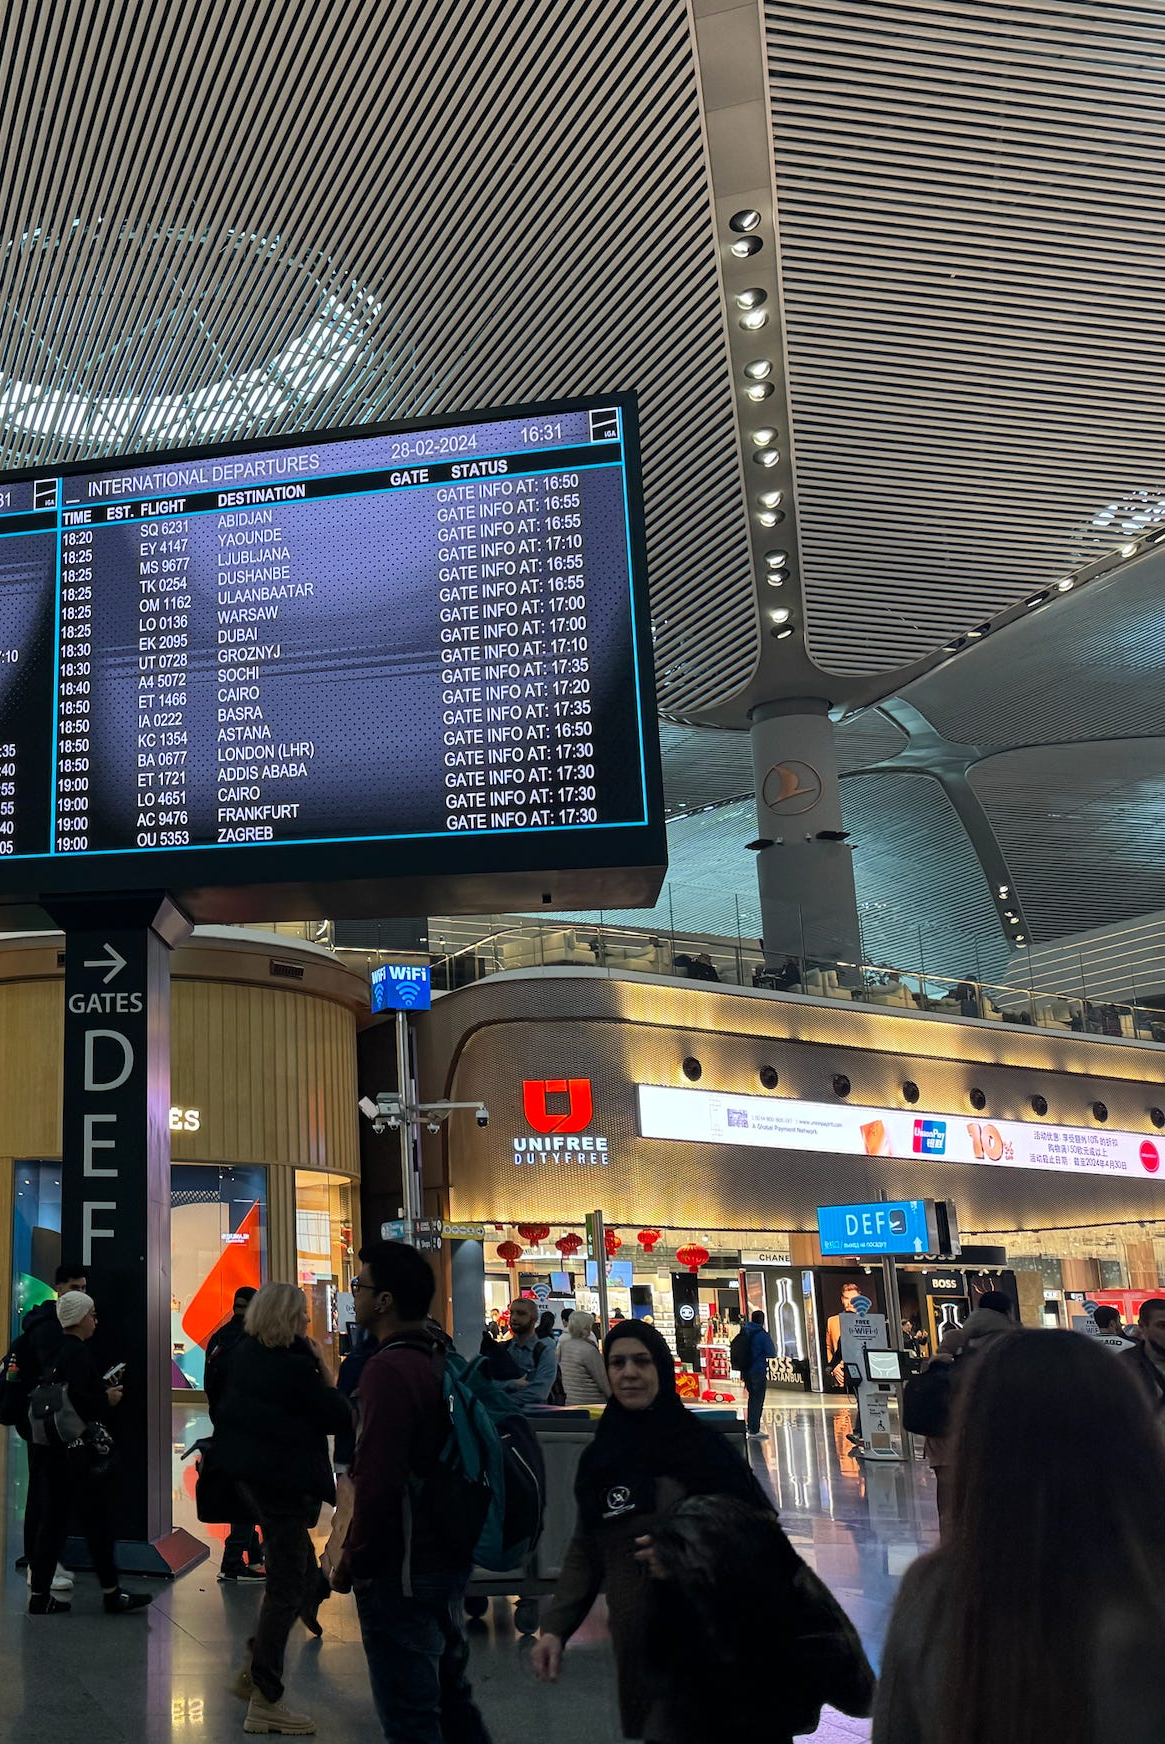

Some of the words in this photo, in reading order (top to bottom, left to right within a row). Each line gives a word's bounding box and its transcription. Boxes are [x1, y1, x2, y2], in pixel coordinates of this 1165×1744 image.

[88, 468, 208, 496] INTERNATIONAL
[212, 453, 319, 481] DEPARTURES
[391, 433, 477, 459] 28-02-2024
[520, 423, 561, 443] 16:31
[62, 509, 92, 525] TIME
[106, 505, 134, 520] EST.
[140, 498, 186, 516] FLIGHT
[218, 483, 305, 507] DESTINATION
[390, 468, 429, 486] GATE
[451, 459, 507, 478] STATUS
[63, 530, 93, 546] 18:20
[140, 523, 158, 537] SQ
[161, 519, 188, 535] 6231
[217, 509, 272, 528] ABIDJAN
[436, 485, 475, 502] GATE
[479, 481, 512, 498] INFO
[516, 478, 537, 494] AT:
[542, 473, 579, 490] 16:50
[60, 661, 90, 676] 18:30
[138, 655, 156, 670] UT
[158, 653, 187, 668] 0728
[218, 644, 280, 663] GROZNYJ
[440, 625, 480, 643] GATE
[483, 622, 518, 639] INFO
[521, 620, 544, 635] AT:
[549, 615, 586, 632] 17:00
[58, 757, 89, 772] 18:50
[138, 753, 155, 767] BA
[158, 750, 187, 766] 0677
[218, 744, 274, 761] LONDON
[278, 741, 314, 760] (LHR)
[443, 728, 483, 745] GATE
[487, 726, 523, 742] INFO
[526, 724, 549, 740] AT:
[554, 720, 592, 737] 16:50
[372, 966, 386, 984] WiFi
[389, 966, 426, 981] WiFi
[68, 993, 143, 1014] GATES
[85, 1030, 133, 1091] D
[513, 1136, 608, 1151] UNIFREE
[914, 1127, 945, 1141] UnionPay
[84, 1115, 118, 1177] E
[514, 1153, 609, 1165] DUTYFREE
[83, 1202, 116, 1265] F
[759, 1253, 790, 1262] CHANE
[932, 1279, 957, 1288] BOSS
[770, 1371, 804, 1384] ISTANBUL
